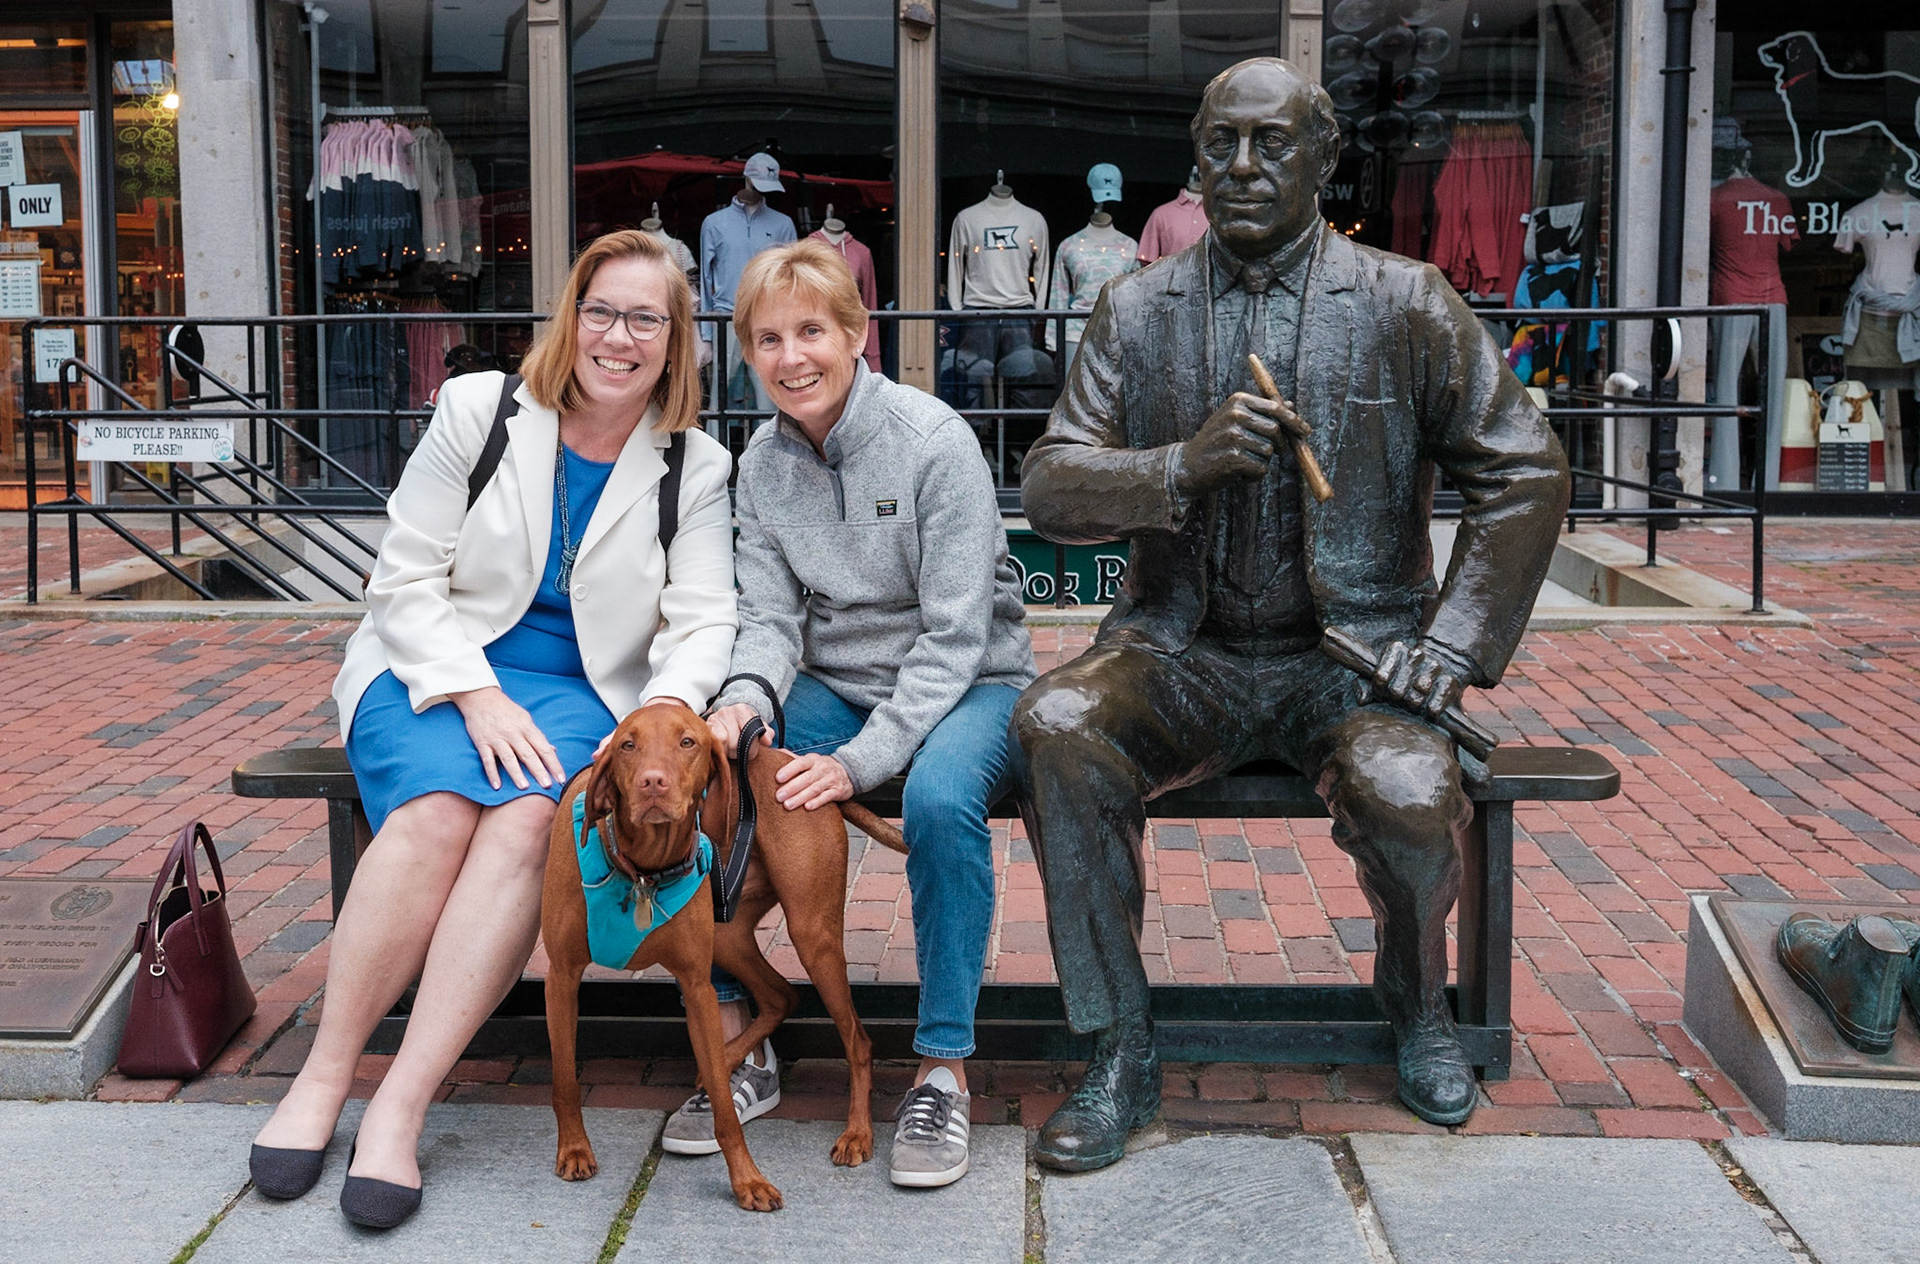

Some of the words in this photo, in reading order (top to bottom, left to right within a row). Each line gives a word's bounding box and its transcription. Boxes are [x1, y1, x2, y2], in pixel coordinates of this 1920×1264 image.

[19, 197, 52, 215] ONLY
[1737, 201, 1796, 235] The
[1806, 201, 1885, 235] Black
[94, 427, 111, 438] NO
[116, 427, 164, 439] BICYCLE
[169, 428, 219, 440] PARKING
[133, 443, 183, 456] PLEASE!!
